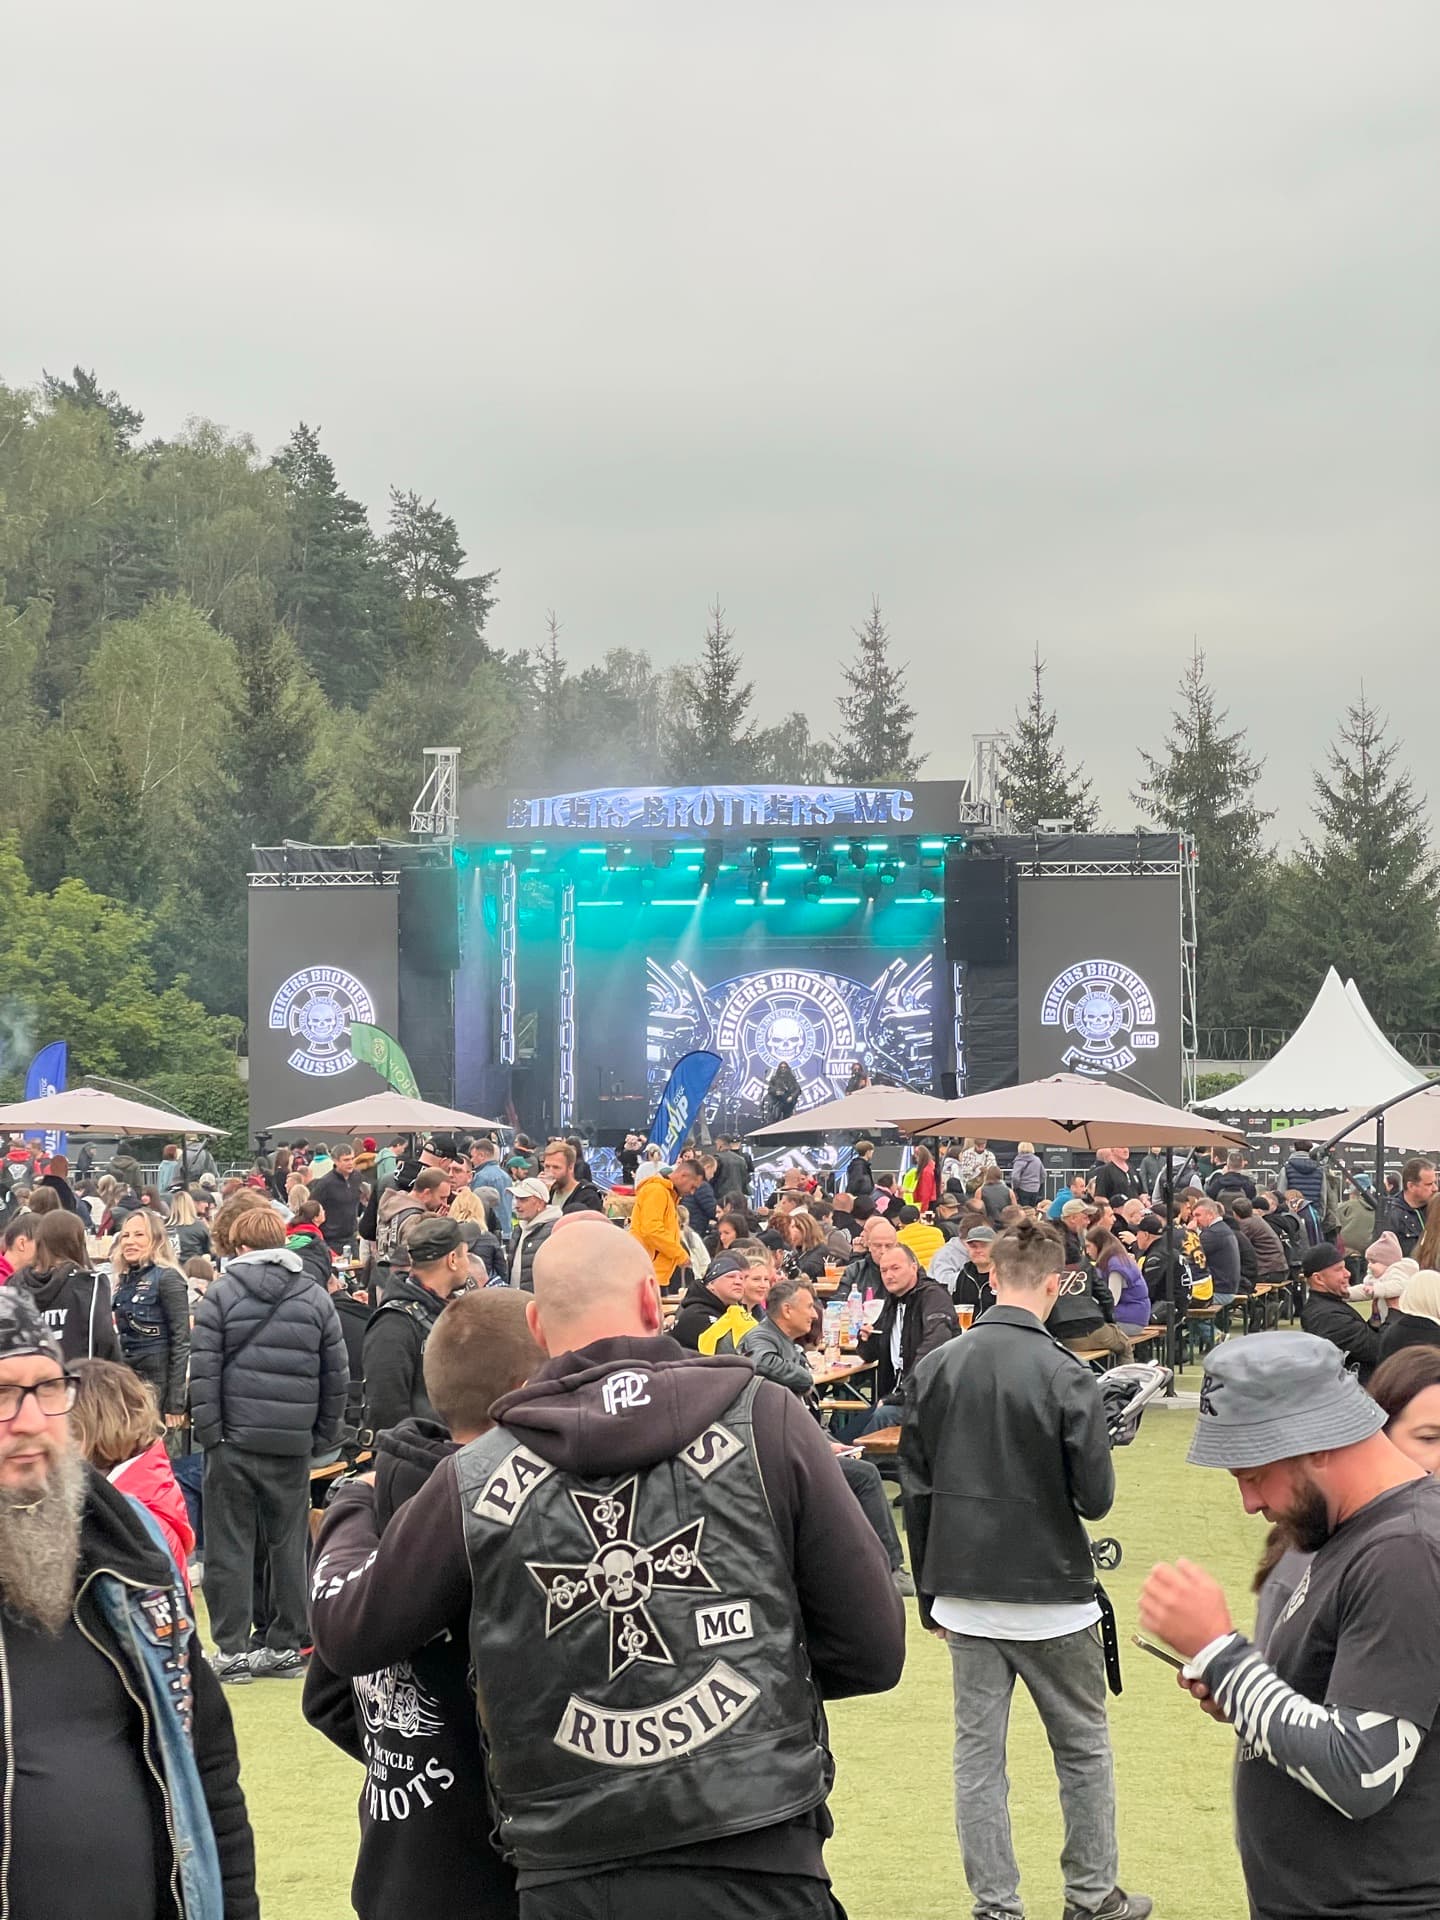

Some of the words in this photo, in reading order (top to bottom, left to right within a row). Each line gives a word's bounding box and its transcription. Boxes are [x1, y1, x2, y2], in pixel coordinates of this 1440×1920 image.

[507, 797, 634, 829] BIKERS
[643, 792, 835, 827] BROTHERS
[272, 972, 309, 1025] BIKERS
[310, 969, 371, 1024] BROTHERS
[721, 978, 769, 1046] BIKERS
[770, 974, 851, 1046] BROTHERS
[1045, 967, 1084, 1021] BIKERS
[1086, 963, 1152, 1021] BROTHERS
[293, 1054, 353, 1073] RUSSIA
[1135, 1035, 1156, 1046] MC
[41, 1308, 69, 1326] ITY
[703, 1609, 746, 1640] MC
[568, 1679, 748, 1758] RUSSIA
[366, 1757, 455, 1821] RIOTS
